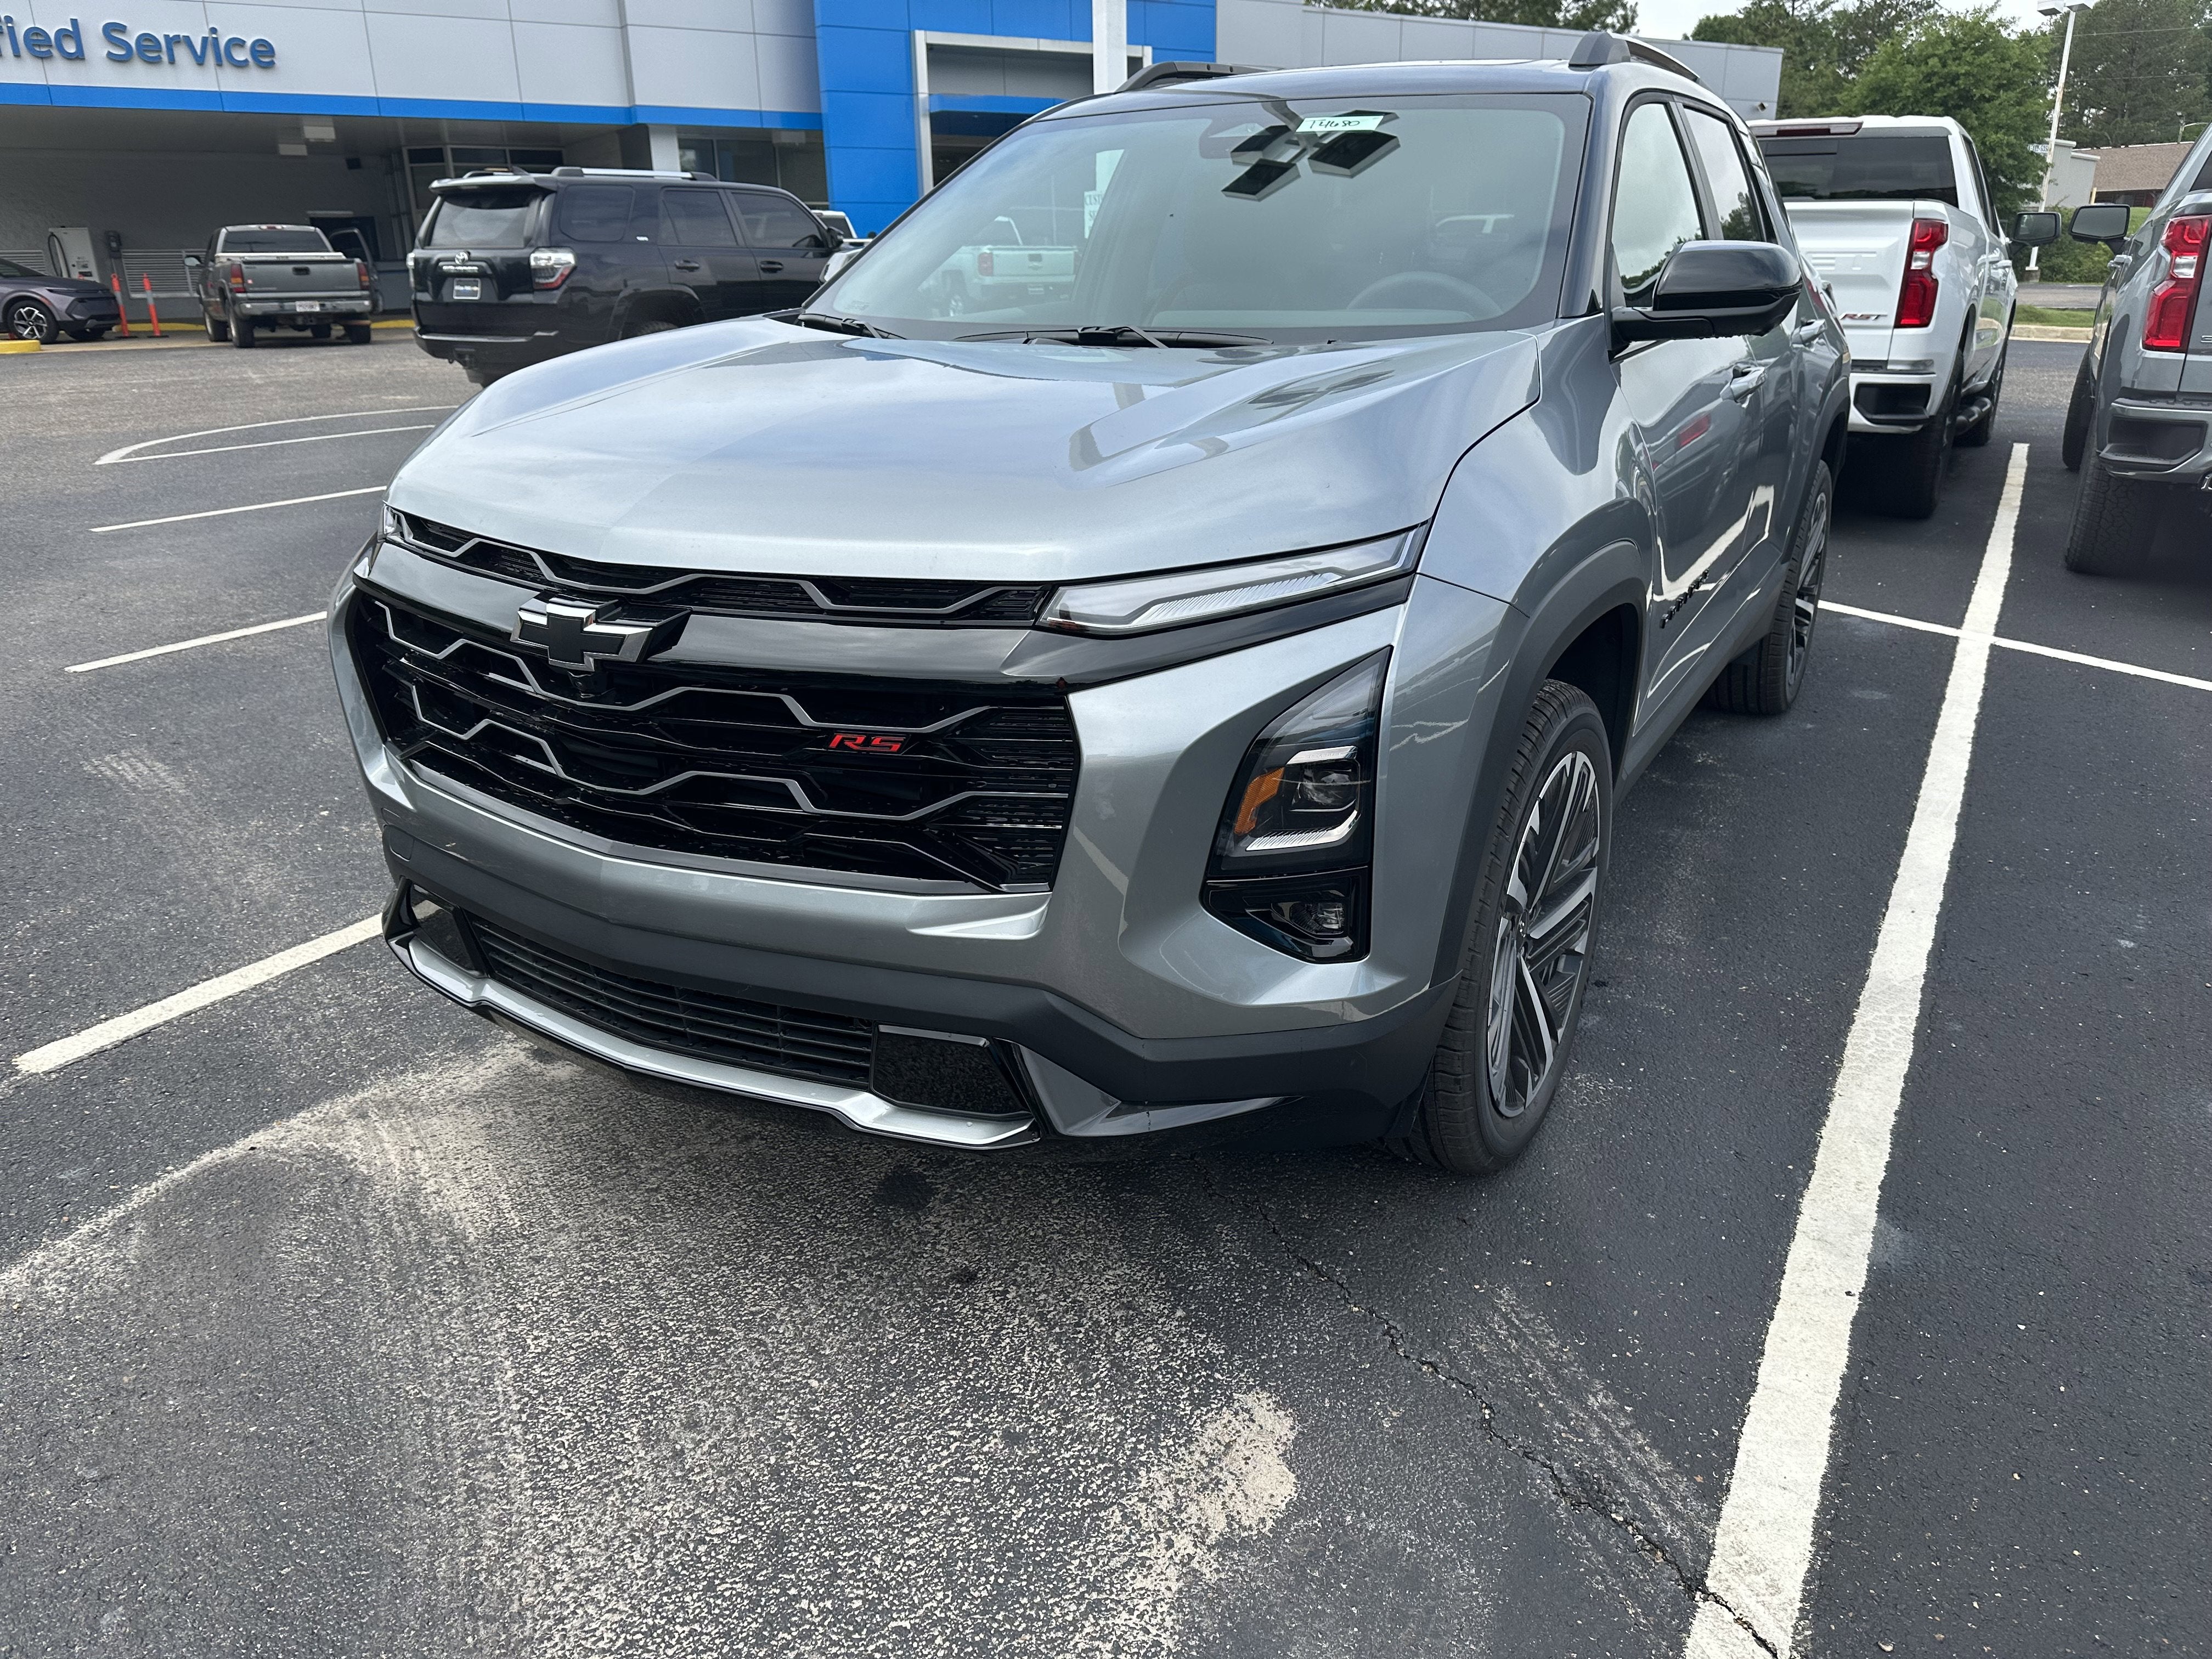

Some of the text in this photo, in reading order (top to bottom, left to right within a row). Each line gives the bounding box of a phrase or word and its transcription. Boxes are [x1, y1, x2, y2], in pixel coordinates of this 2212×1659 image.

[101, 21, 276, 69] Service
[1839, 313, 1888, 321] RST
[828, 732, 906, 752] RS
